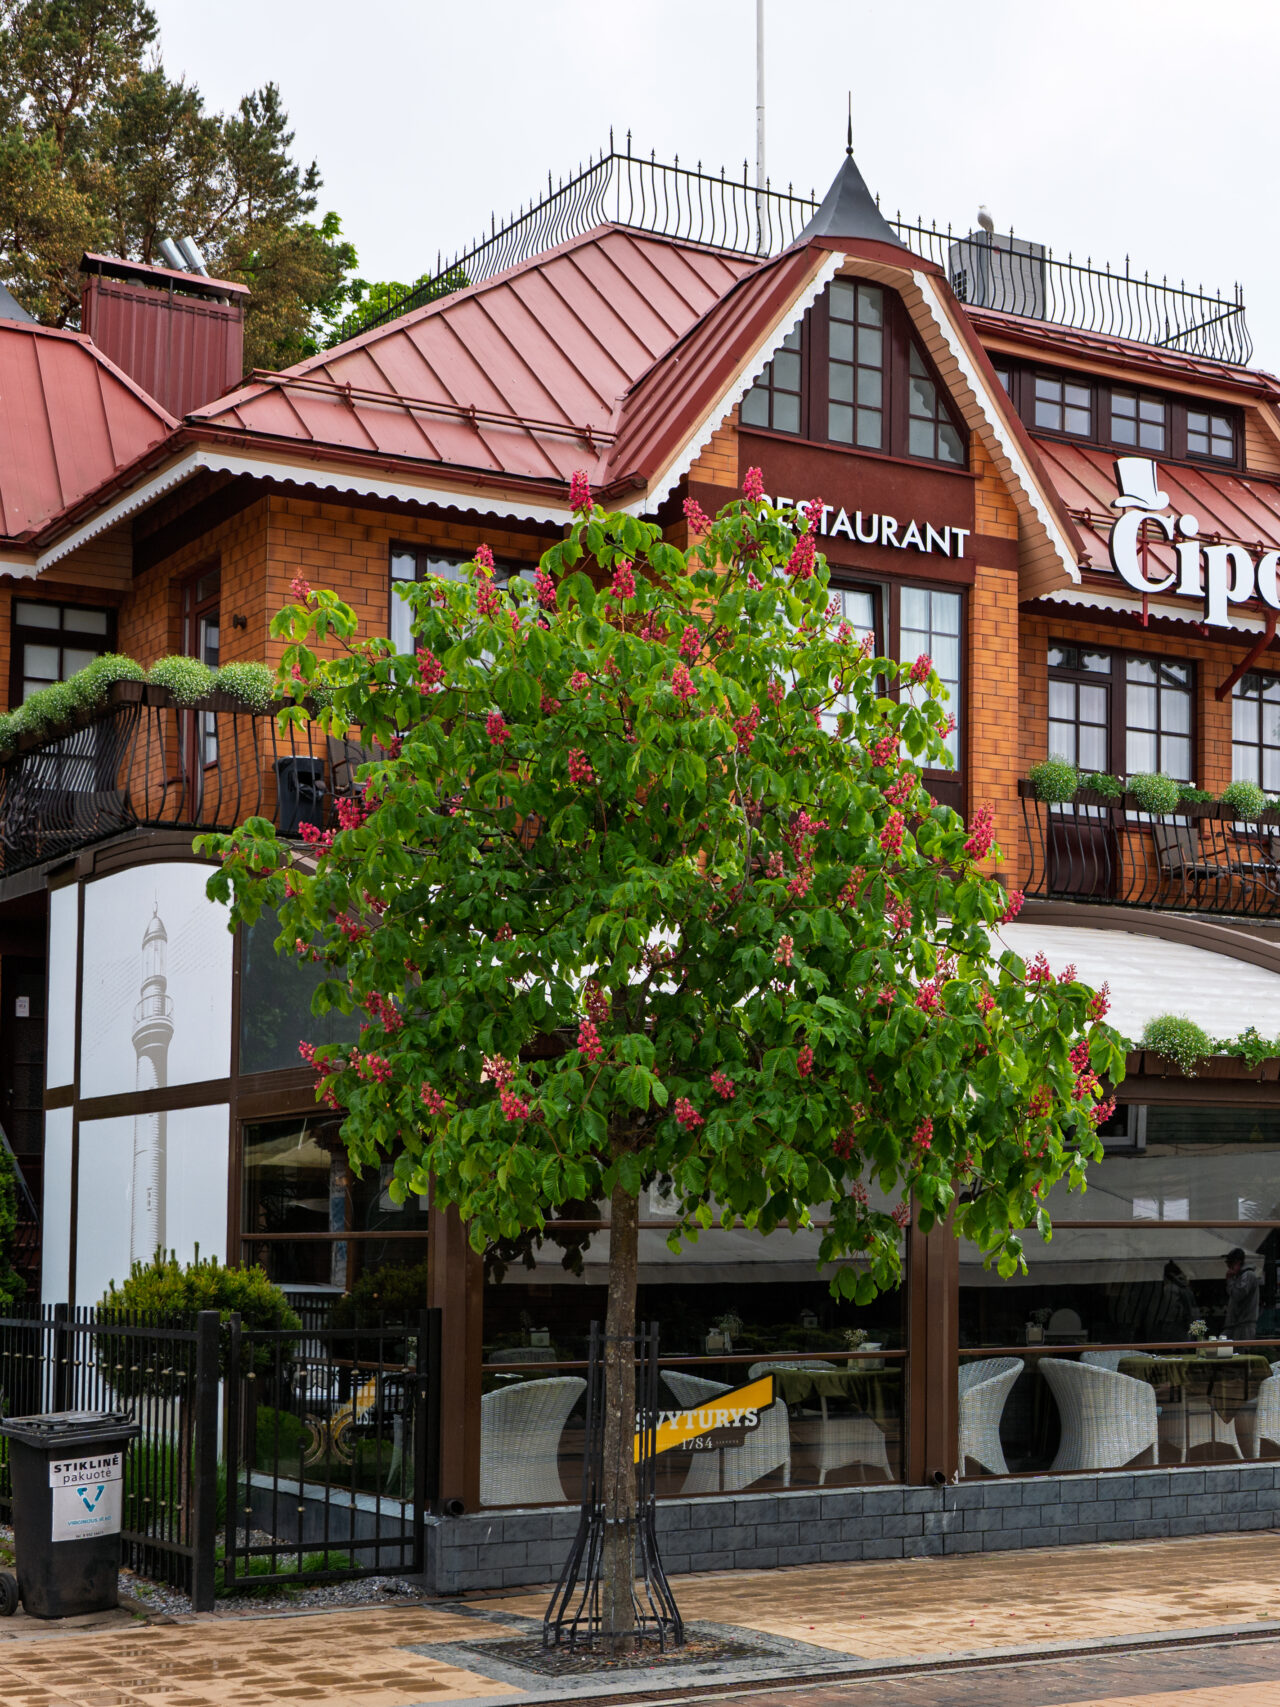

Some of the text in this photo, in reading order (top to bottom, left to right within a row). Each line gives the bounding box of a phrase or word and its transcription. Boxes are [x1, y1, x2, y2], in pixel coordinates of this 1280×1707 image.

[681, 1436, 713, 1450] 1784
[54, 1455, 119, 1473] STIKLINĖ
[63, 1468, 112, 1485] pakuotė
